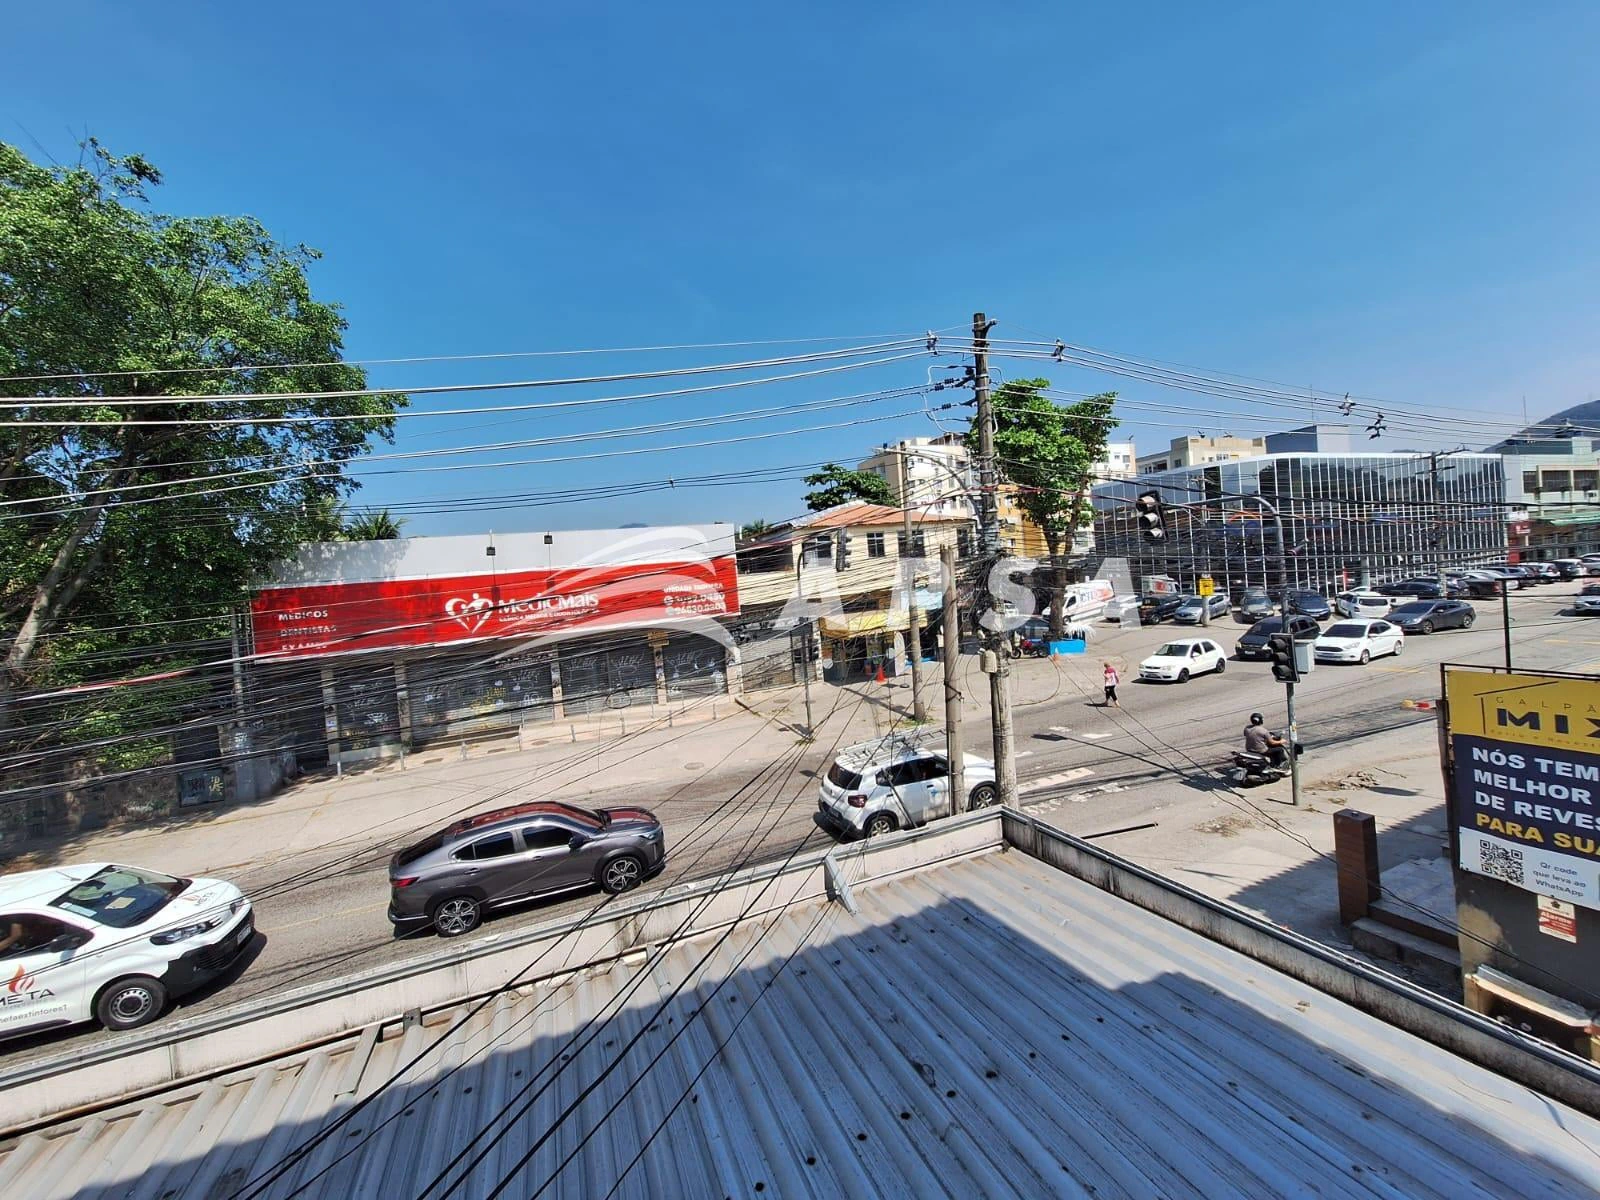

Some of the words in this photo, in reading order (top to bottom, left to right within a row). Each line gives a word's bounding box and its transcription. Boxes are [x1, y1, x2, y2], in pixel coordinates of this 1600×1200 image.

[278, 609, 329, 621] MÉDICOS
[1472, 747, 1526, 769] NÓS
[1534, 757, 1600, 782] TEM
[1473, 768, 1592, 805] MELHOR
[1475, 790, 1506, 811] DE
[1476, 812, 1544, 843] PARA
[1533, 870, 1550, 878] que
[1552, 874, 1572, 885] leva
[1554, 865, 1578, 876] code
[1535, 879, 1584, 897] WhatsApp
